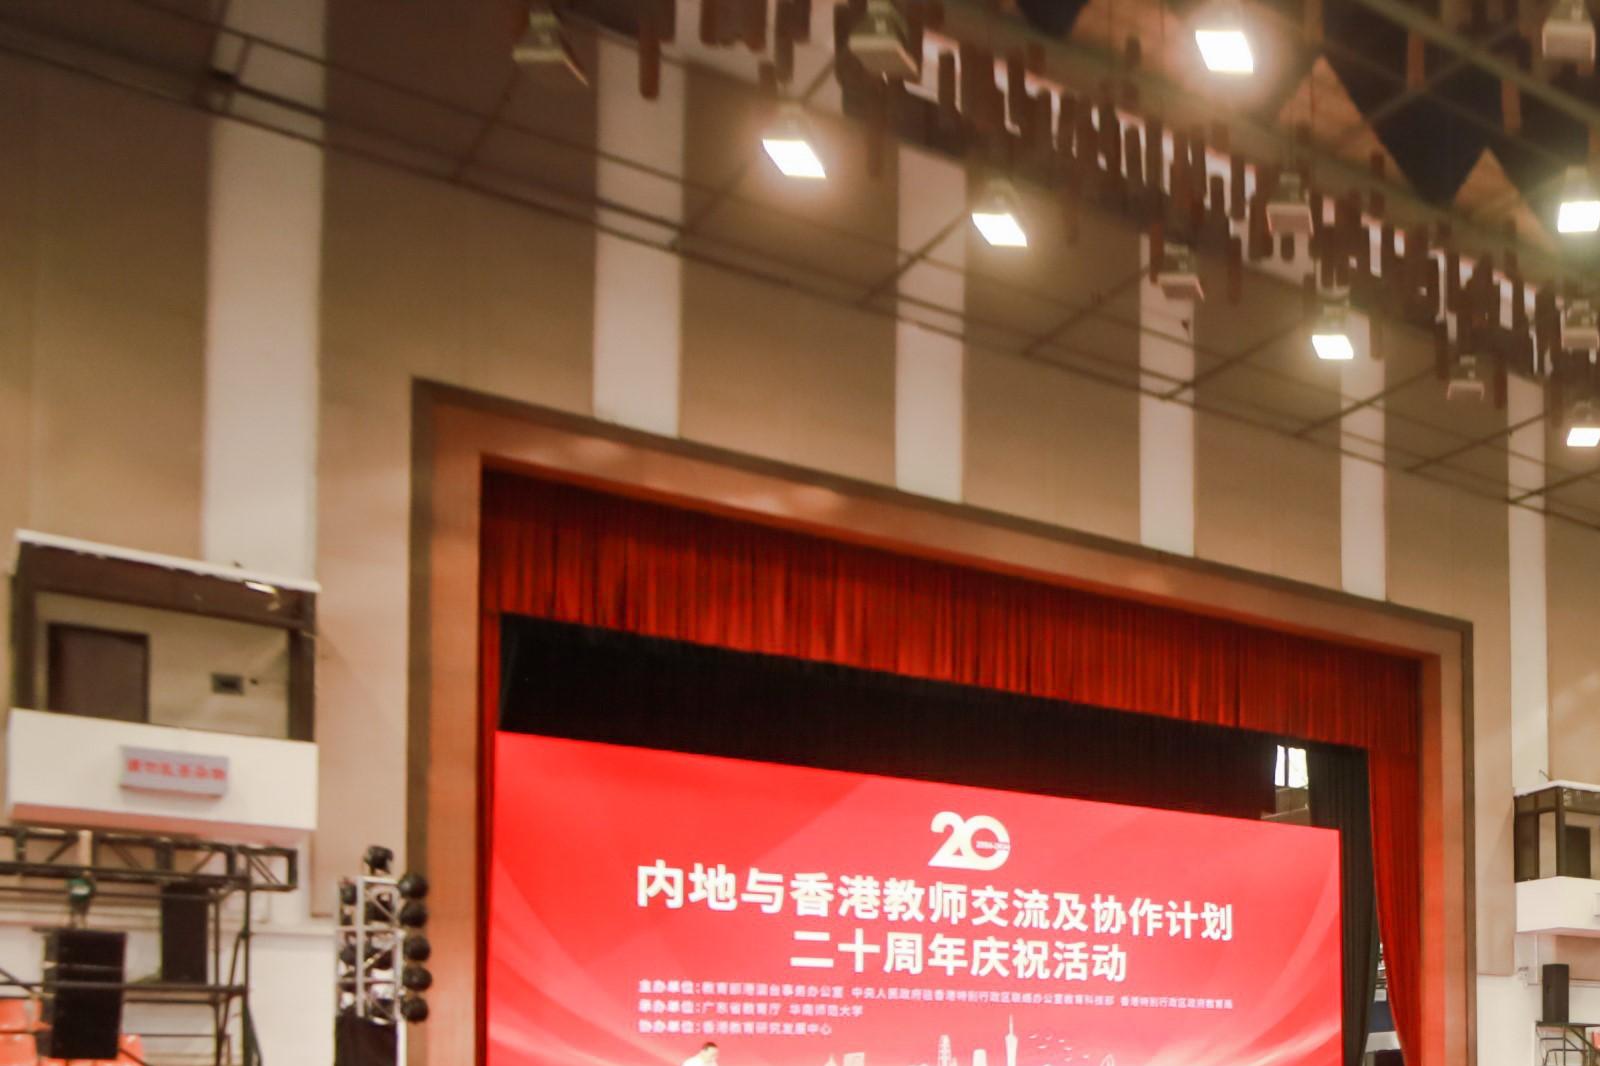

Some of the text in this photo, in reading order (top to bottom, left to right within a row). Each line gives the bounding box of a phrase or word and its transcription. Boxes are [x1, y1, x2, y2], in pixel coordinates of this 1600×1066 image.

[928, 811, 1010, 871] 20
[637, 859, 1234, 942] 内地与香港教师交流及协作计划
[790, 929, 1128, 983] 二十周年庆祝活动
